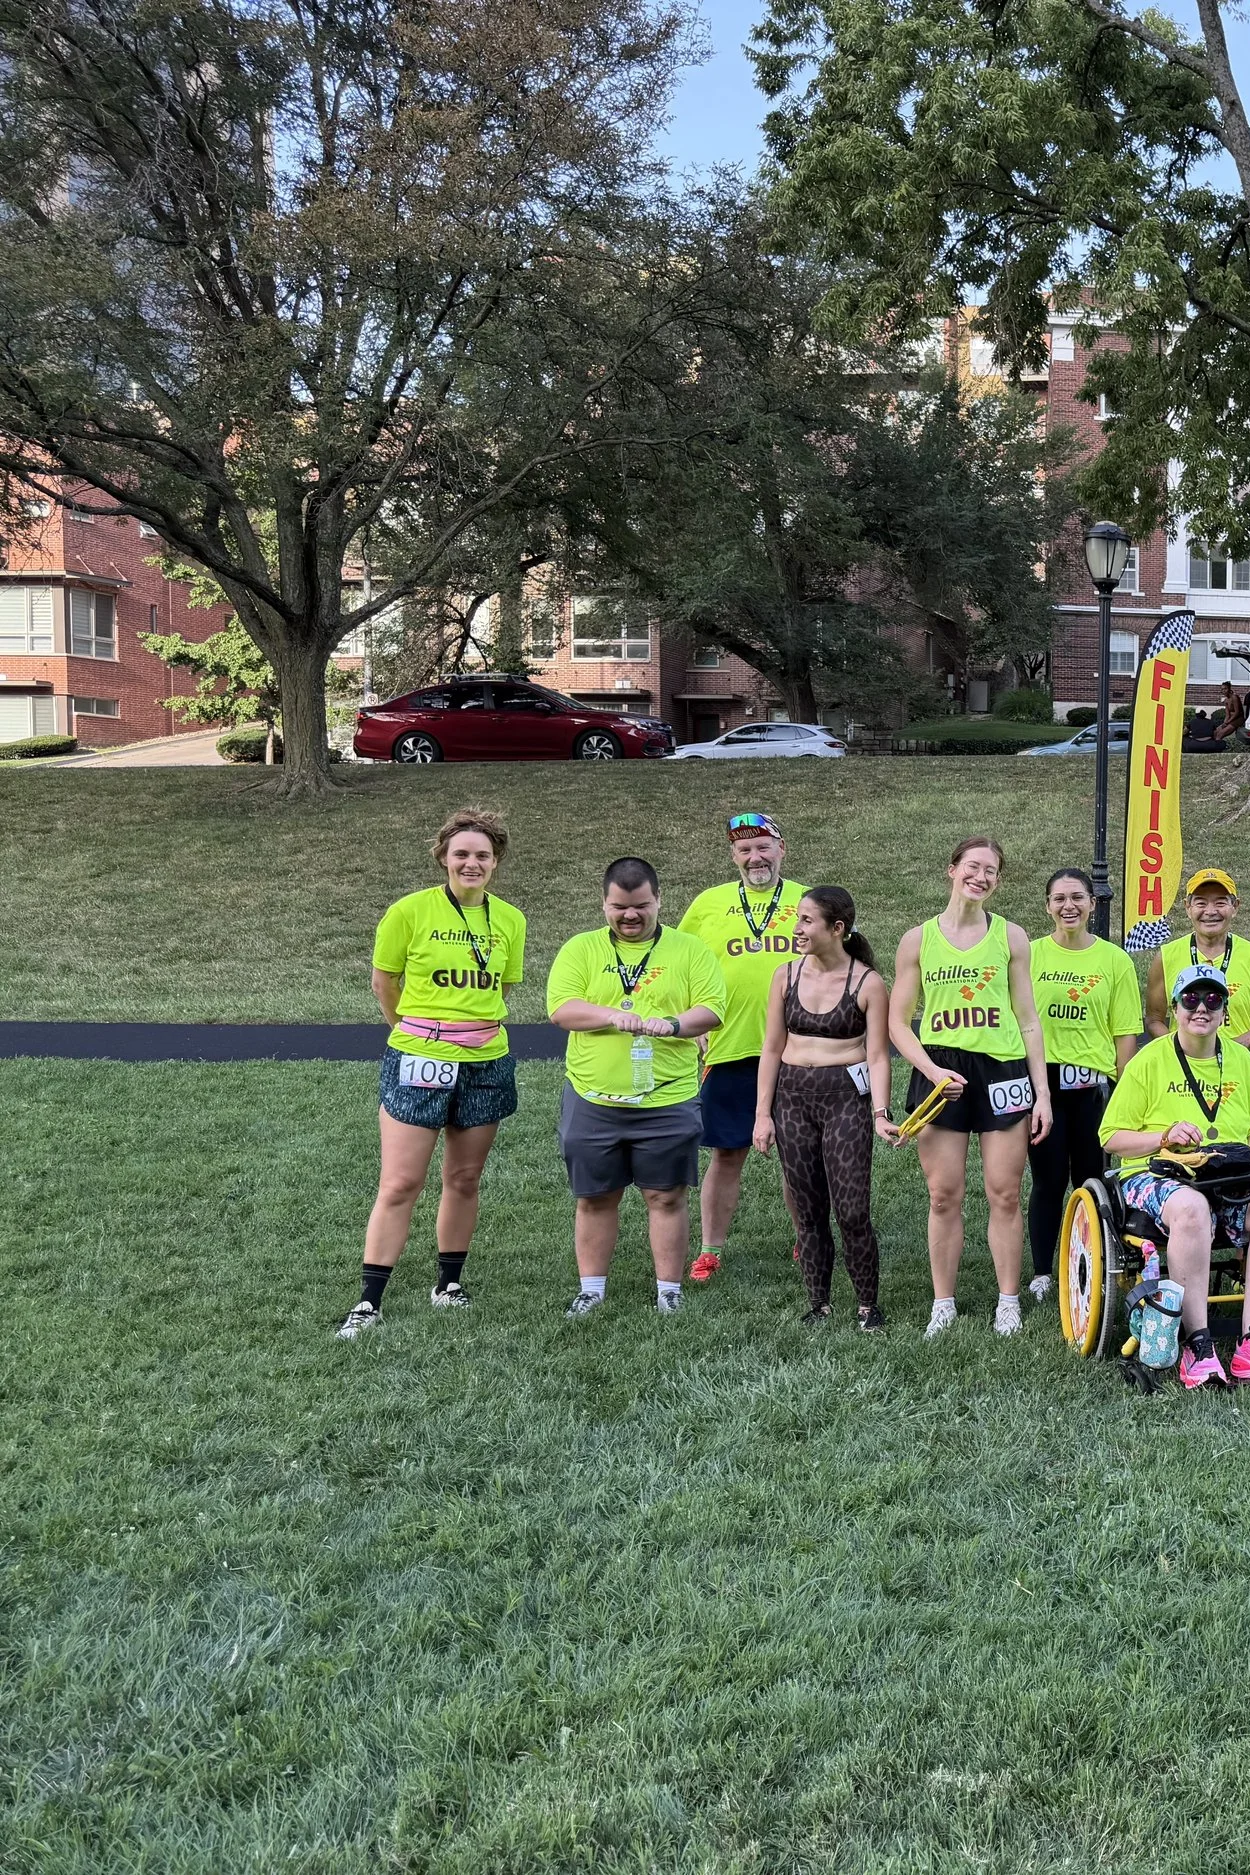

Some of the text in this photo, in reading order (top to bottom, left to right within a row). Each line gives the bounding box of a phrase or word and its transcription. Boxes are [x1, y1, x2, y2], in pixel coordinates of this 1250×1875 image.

[1138, 658, 1176, 916] FINISH
[726, 903, 781, 916] Acills
[602, 963, 648, 975] Acills
[925, 965, 979, 984] Achilles
[1038, 971, 1086, 984] Achilles
[1195, 965, 1213, 977] KC
[432, 969, 501, 991] GUIDE
[931, 1006, 1000, 1032] GUIDE
[1047, 1003, 1088, 1021] GUIDE
[405, 1060, 454, 1085] 108
[1167, 1079, 1220, 1093] Achlles
[993, 1081, 1031, 1110] 098
